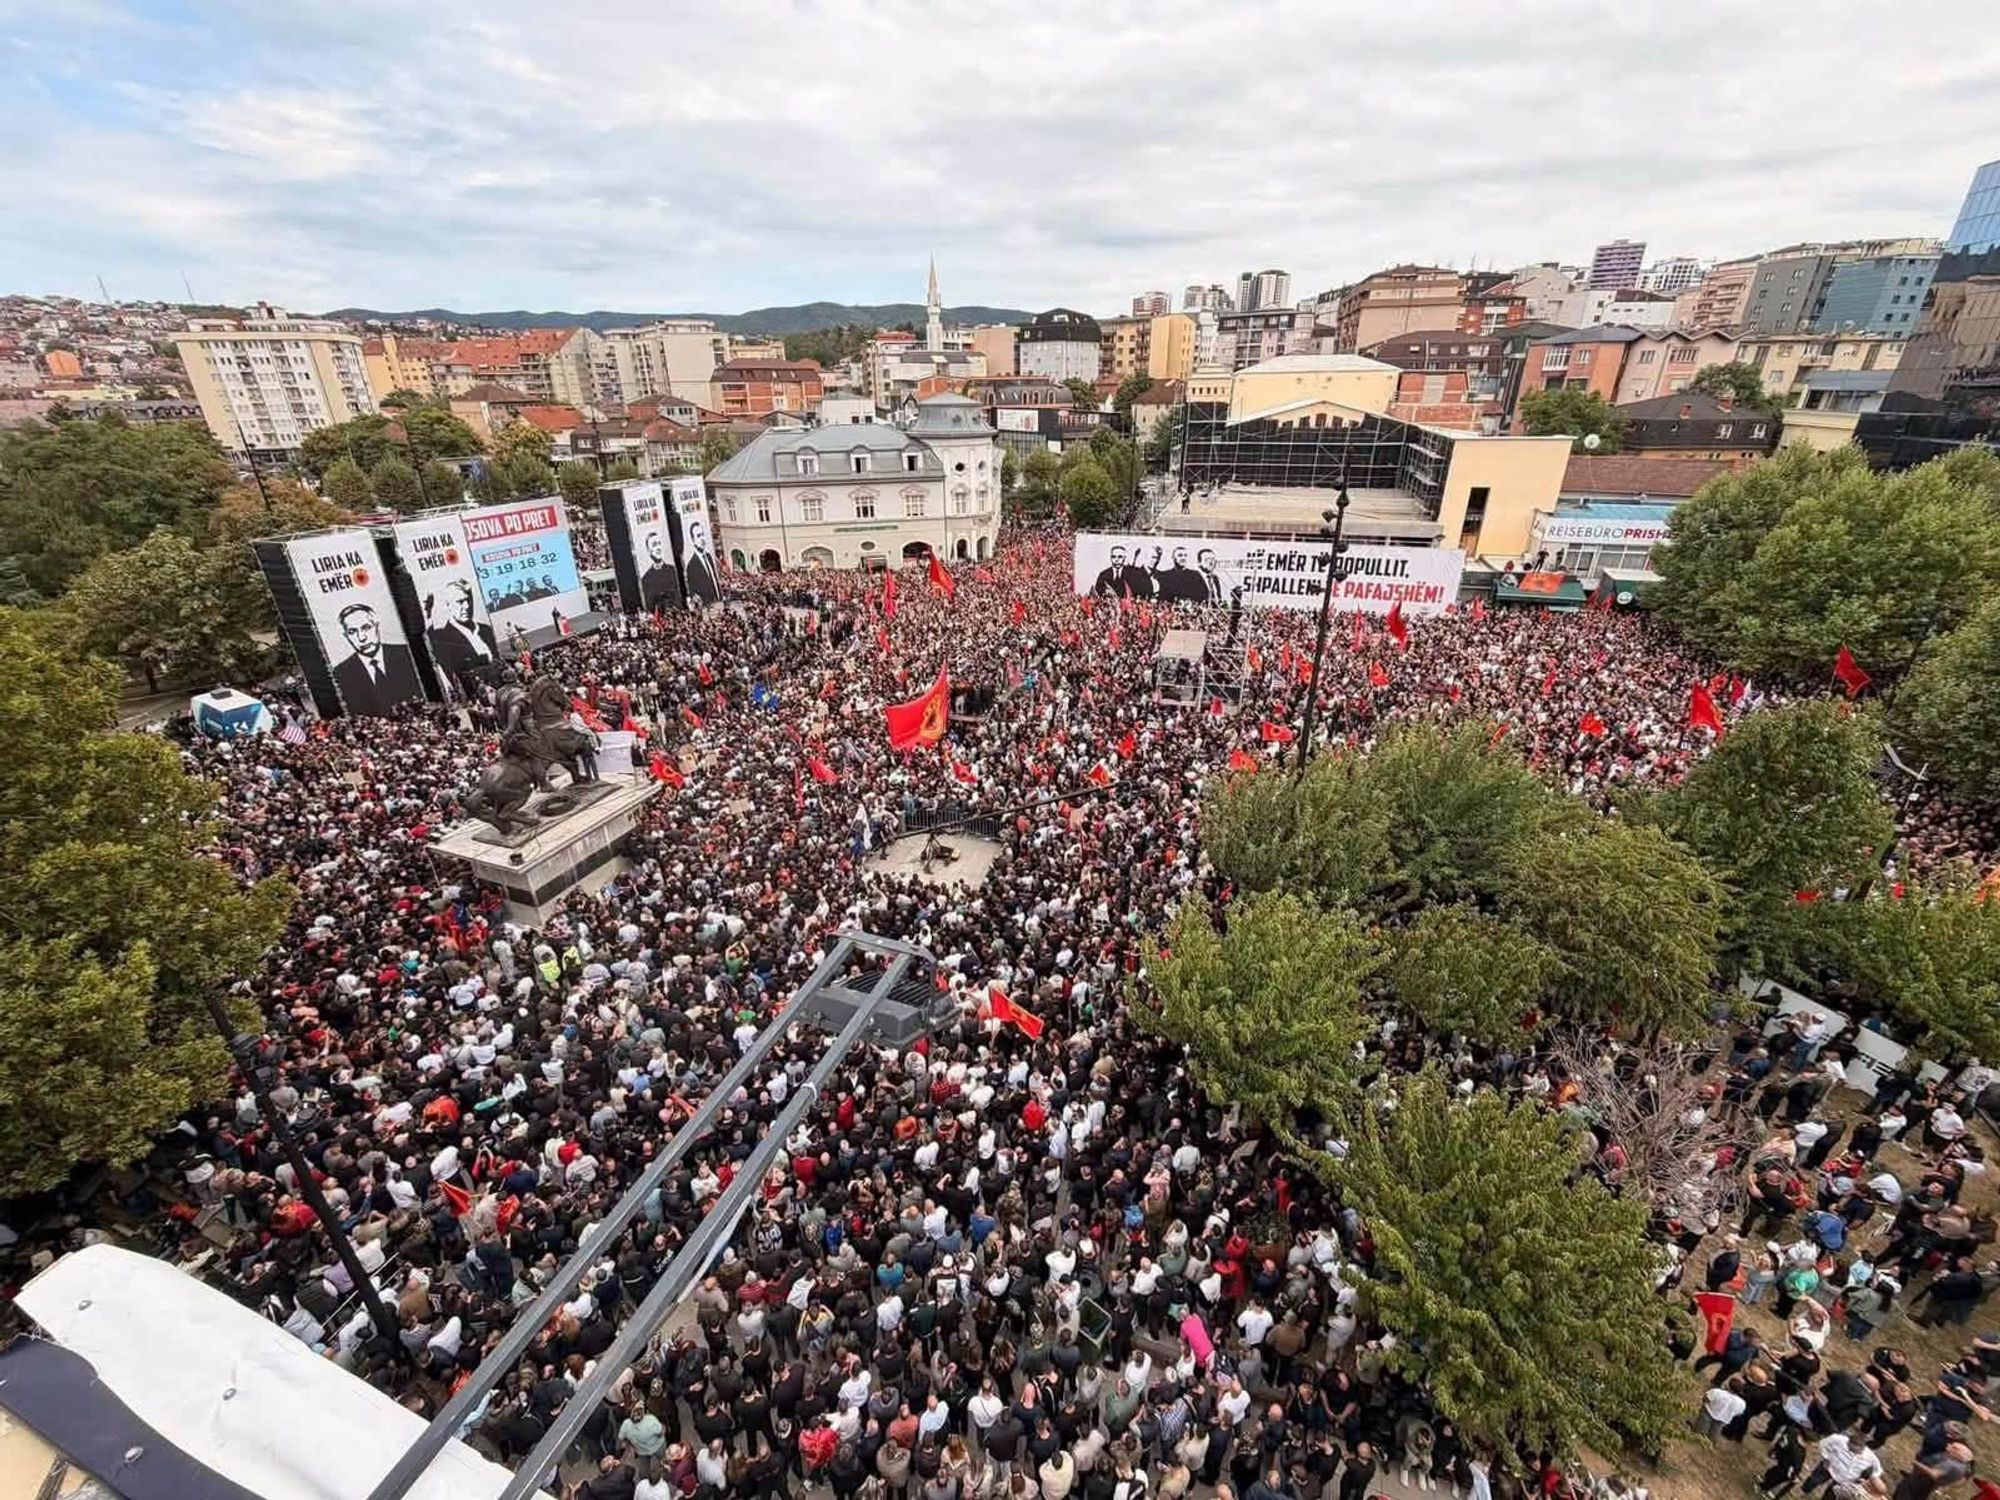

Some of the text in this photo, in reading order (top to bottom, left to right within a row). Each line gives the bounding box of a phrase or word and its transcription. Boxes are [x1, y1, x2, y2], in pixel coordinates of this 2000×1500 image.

[503, 513, 523, 533] PO
[522, 509, 552, 531] PRET
[412, 532, 455, 553] LIRIA KA
[310, 550, 363, 573] LIRIA KA
[417, 552, 446, 571] EMËR
[1266, 550, 1307, 572] EMËR
[318, 572, 353, 593] EMËR
[1344, 581, 1445, 603] PAFAJSHËM!
